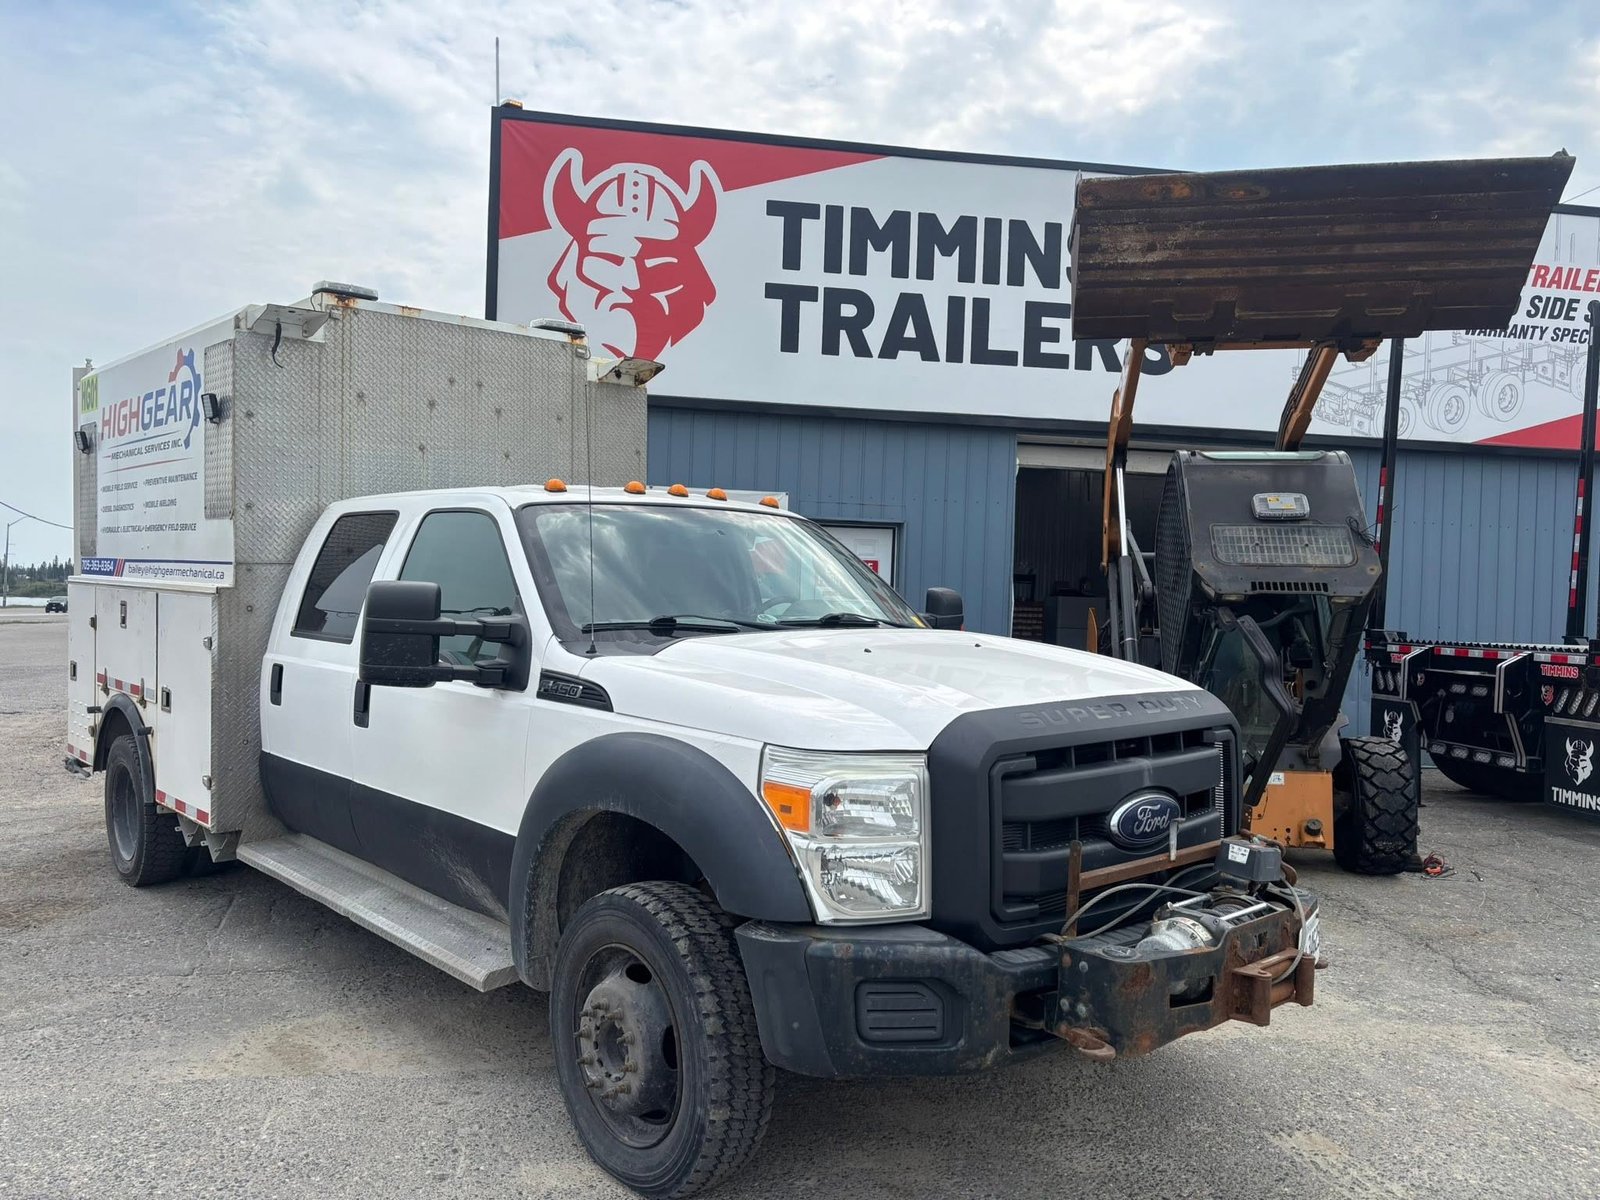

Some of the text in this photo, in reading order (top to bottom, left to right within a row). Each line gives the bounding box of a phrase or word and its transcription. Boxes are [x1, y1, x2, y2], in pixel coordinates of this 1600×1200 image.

[766, 200, 1074, 290] TIMMIN
[1526, 295, 1580, 321] SIDE
[101, 379, 193, 441] HIGHGEAR
[111, 438, 183, 461] MECHANICAL SERVICES INC.
[179, 523, 197, 532] SERVICE
[128, 563, 225, 580] bailey@highgearmechanical.ca
[1541, 664, 1579, 679] TIMMINS
[1016, 694, 1202, 728] SUPER DUTY
[1134, 804, 1170, 835] Ford
